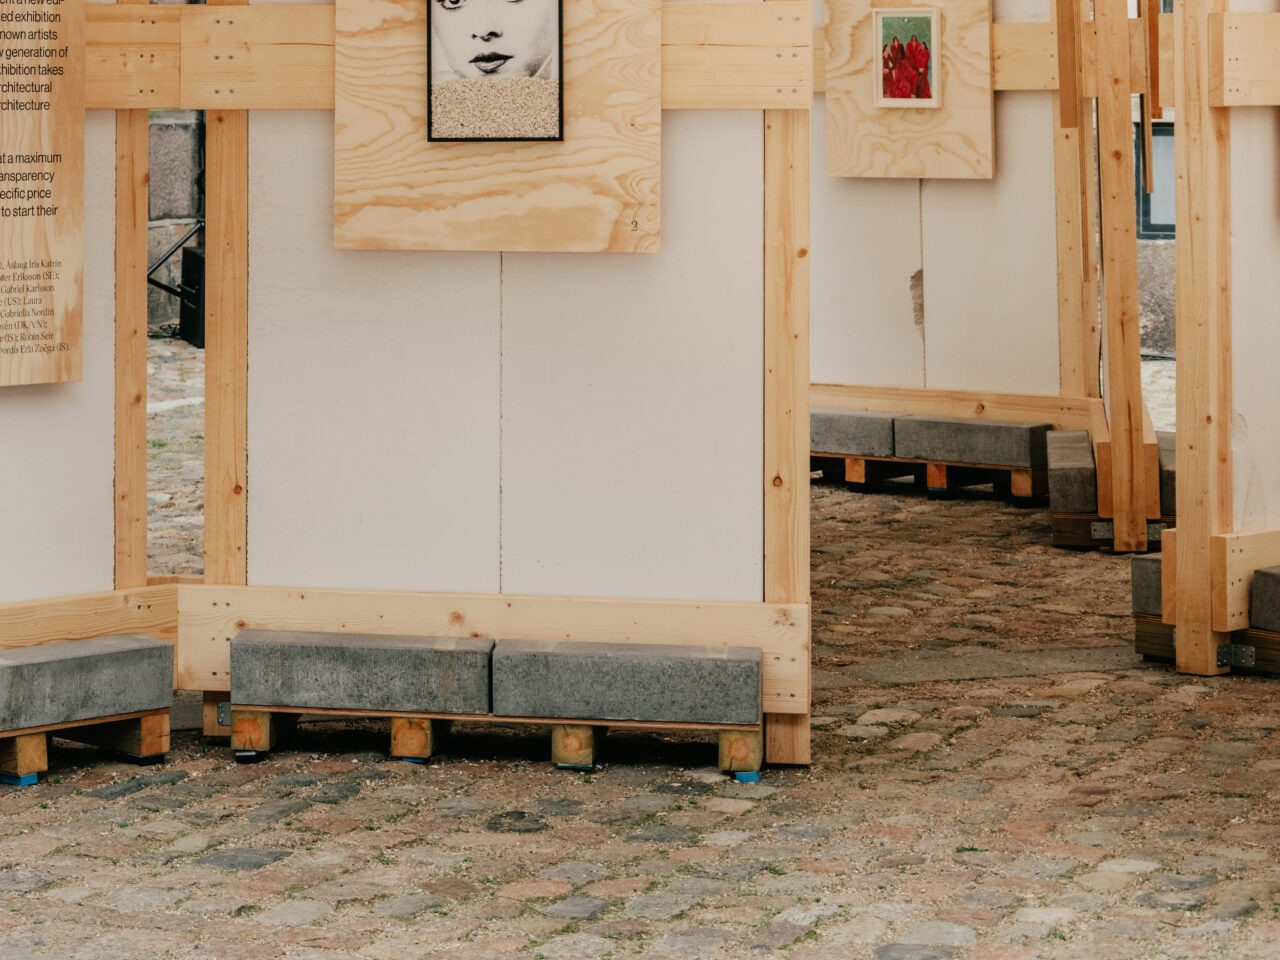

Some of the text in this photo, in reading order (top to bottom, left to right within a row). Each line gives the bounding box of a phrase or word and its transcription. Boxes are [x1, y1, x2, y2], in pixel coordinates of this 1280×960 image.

[14, 9, 60, 22] exhibition
[28, 27, 57, 39] artists
[37, 62, 63, 75] takes
[7, 153, 13, 163] a
[15, 150, 61, 163] maximum
[26, 185, 51, 201] price
[1, 204, 10, 217] to
[12, 203, 34, 216] start
[36, 203, 56, 216] their
[631, 220, 638, 232] 2
